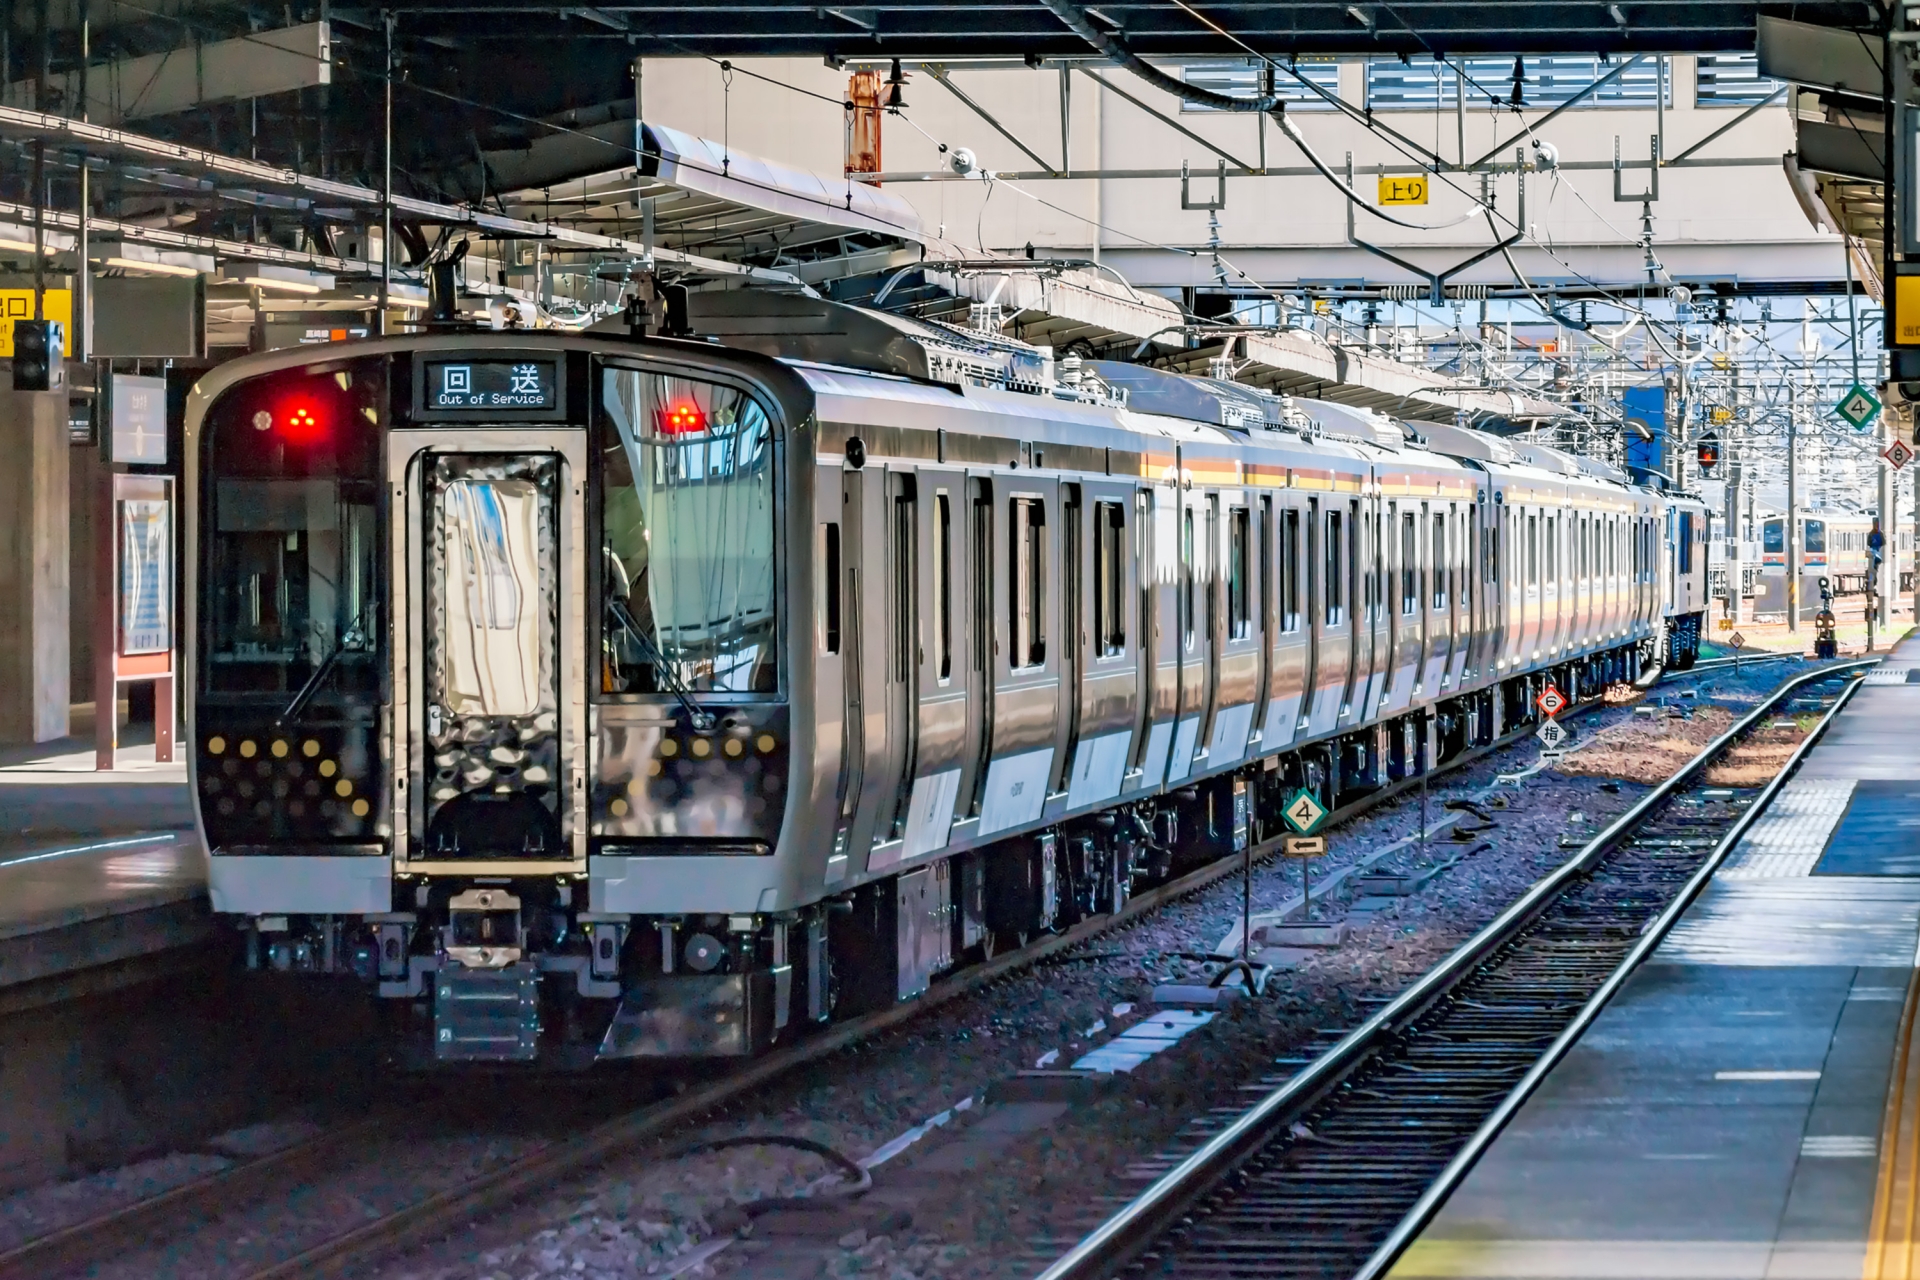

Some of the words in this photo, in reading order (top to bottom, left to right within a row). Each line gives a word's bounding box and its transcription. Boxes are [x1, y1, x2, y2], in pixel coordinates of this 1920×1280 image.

[1385, 182, 1422, 201] 上り
[0, 297, 27, 318] 口
[439, 393, 463, 405] Out
[469, 393, 485, 405] of
[491, 392, 544, 404] Service
[1850, 399, 1866, 415] 4
[1894, 446, 1903, 462] 8
[1545, 695, 1558, 708] 6
[1544, 725, 1559, 742] 指
[1295, 803, 1313, 822] 4
